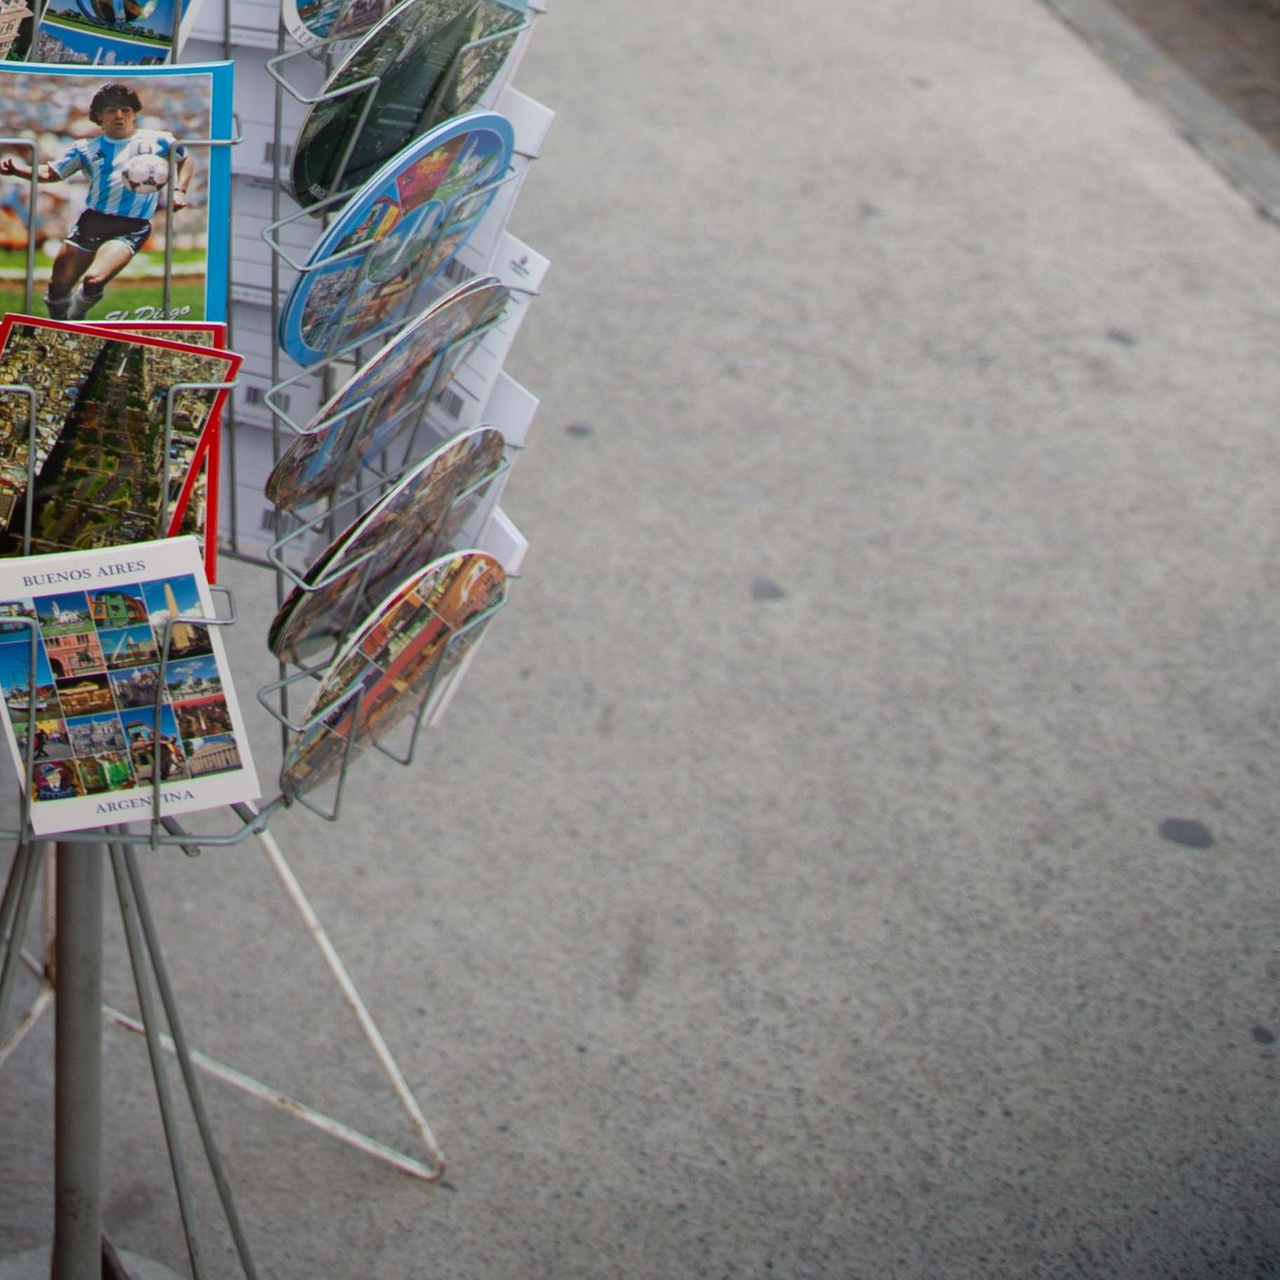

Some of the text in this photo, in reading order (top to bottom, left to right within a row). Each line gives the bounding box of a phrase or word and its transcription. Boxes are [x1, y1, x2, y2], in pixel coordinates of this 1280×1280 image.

[22, 560, 147, 587] BUENOS AIRES
[95, 789, 196, 814] ARGENINA
